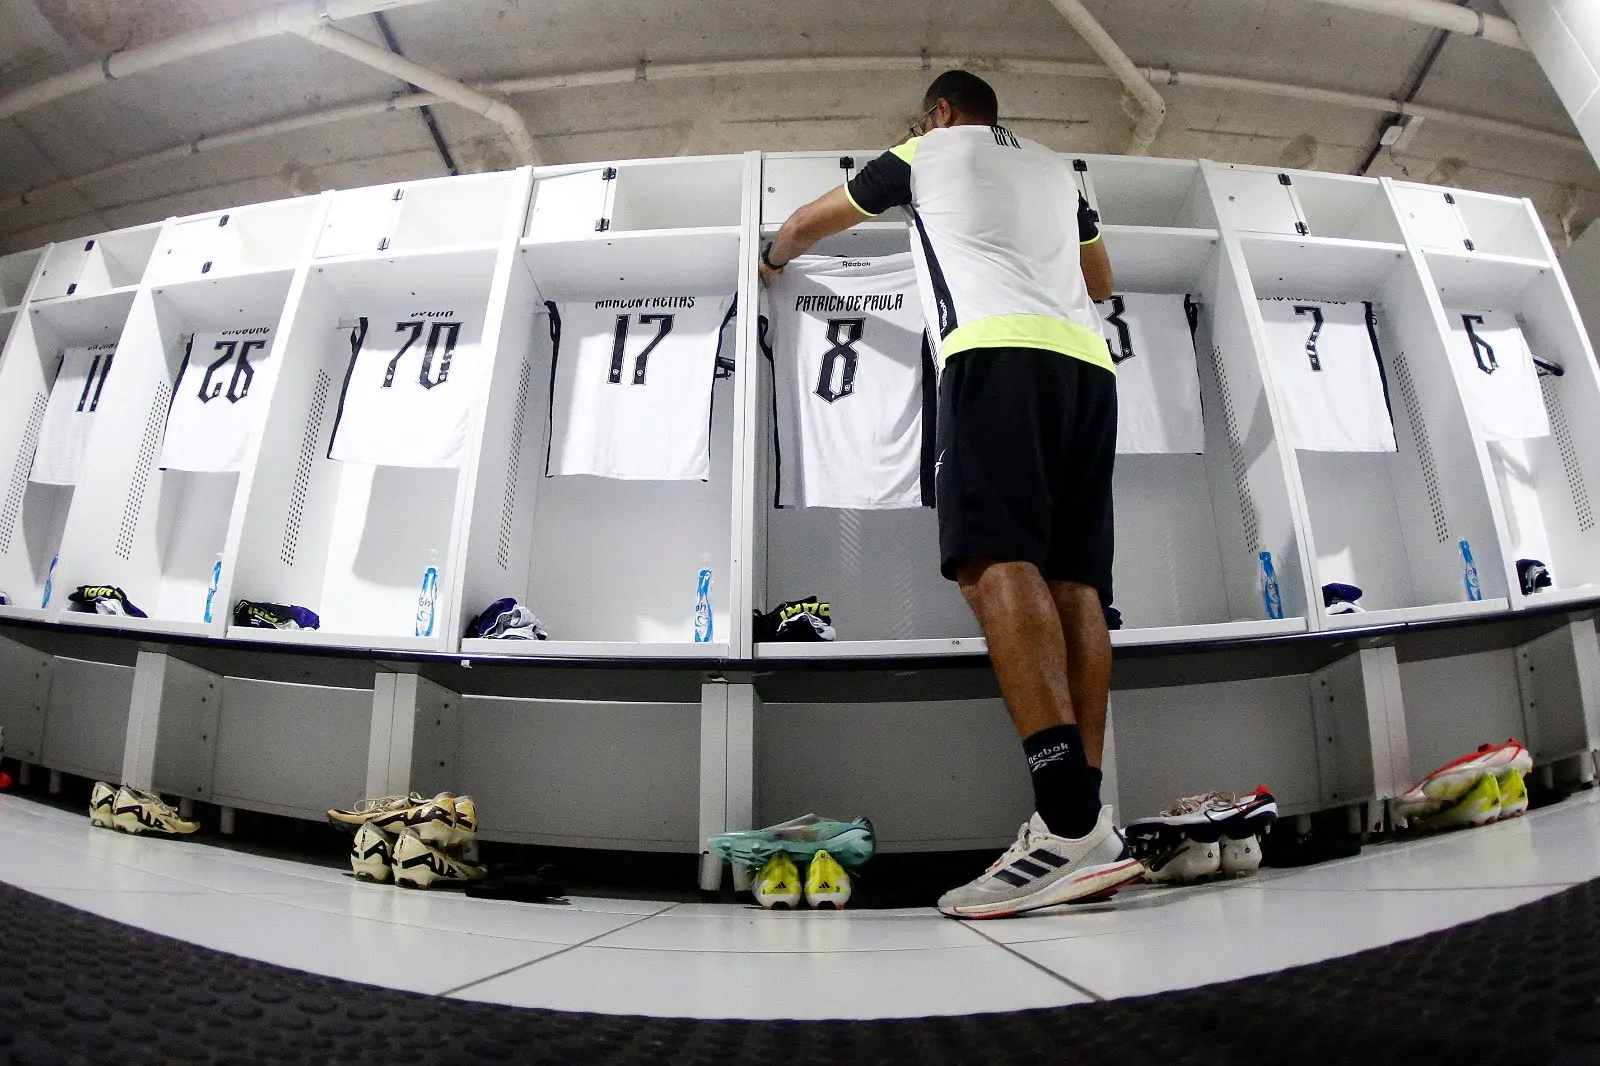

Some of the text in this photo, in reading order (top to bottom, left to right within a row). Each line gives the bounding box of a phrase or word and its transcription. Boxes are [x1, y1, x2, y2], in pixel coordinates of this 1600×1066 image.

[795, 293, 904, 312] PATRICK DE PAULA
[1093, 295, 1136, 365] 3
[380, 320, 463, 391] 70
[606, 313, 675, 385] 17
[813, 317, 866, 405] 8
[1293, 305, 1324, 371] 7
[1460, 313, 1499, 375] 6
[75, 354, 115, 412] 11
[196, 340, 267, 405] 26
